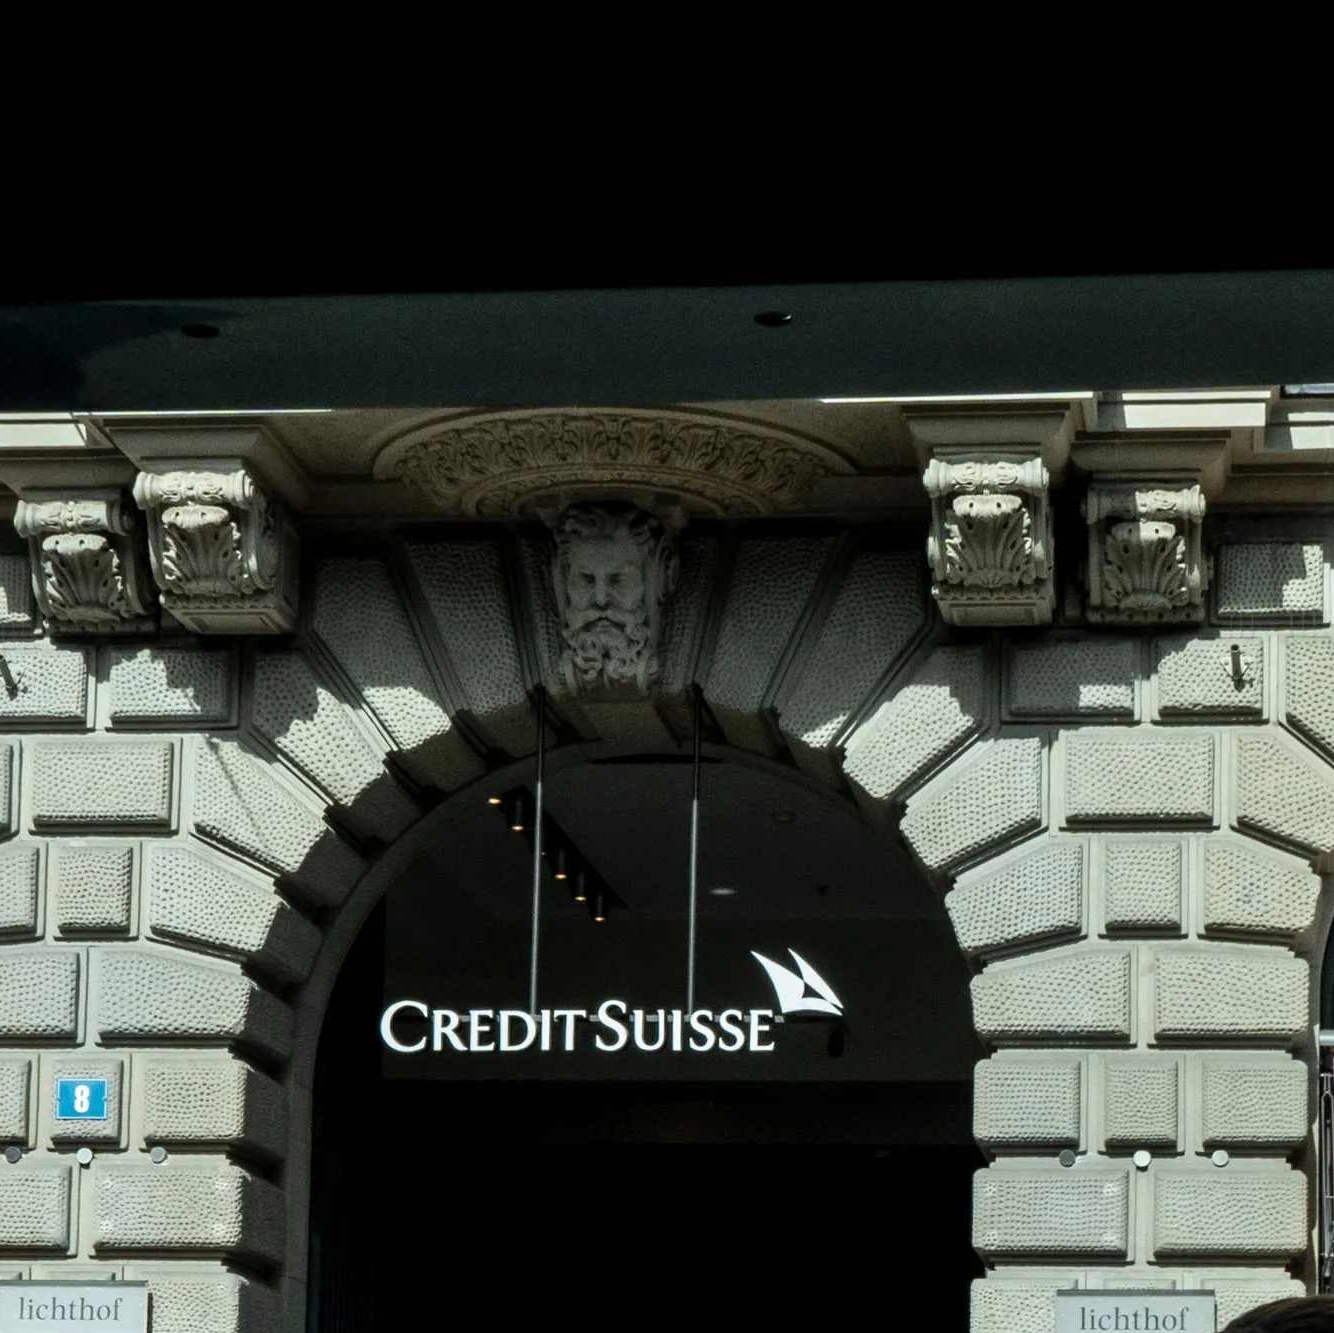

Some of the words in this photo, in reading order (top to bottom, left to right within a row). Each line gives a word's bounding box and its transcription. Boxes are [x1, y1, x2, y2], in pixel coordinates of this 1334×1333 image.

[380, 999, 587, 1053] CREDIT
[595, 999, 776, 1053] SUISSE
[73, 1084, 90, 1114] 8
[18, 1296, 123, 1321] lichthof
[1080, 1306, 1189, 1331] lichthof
